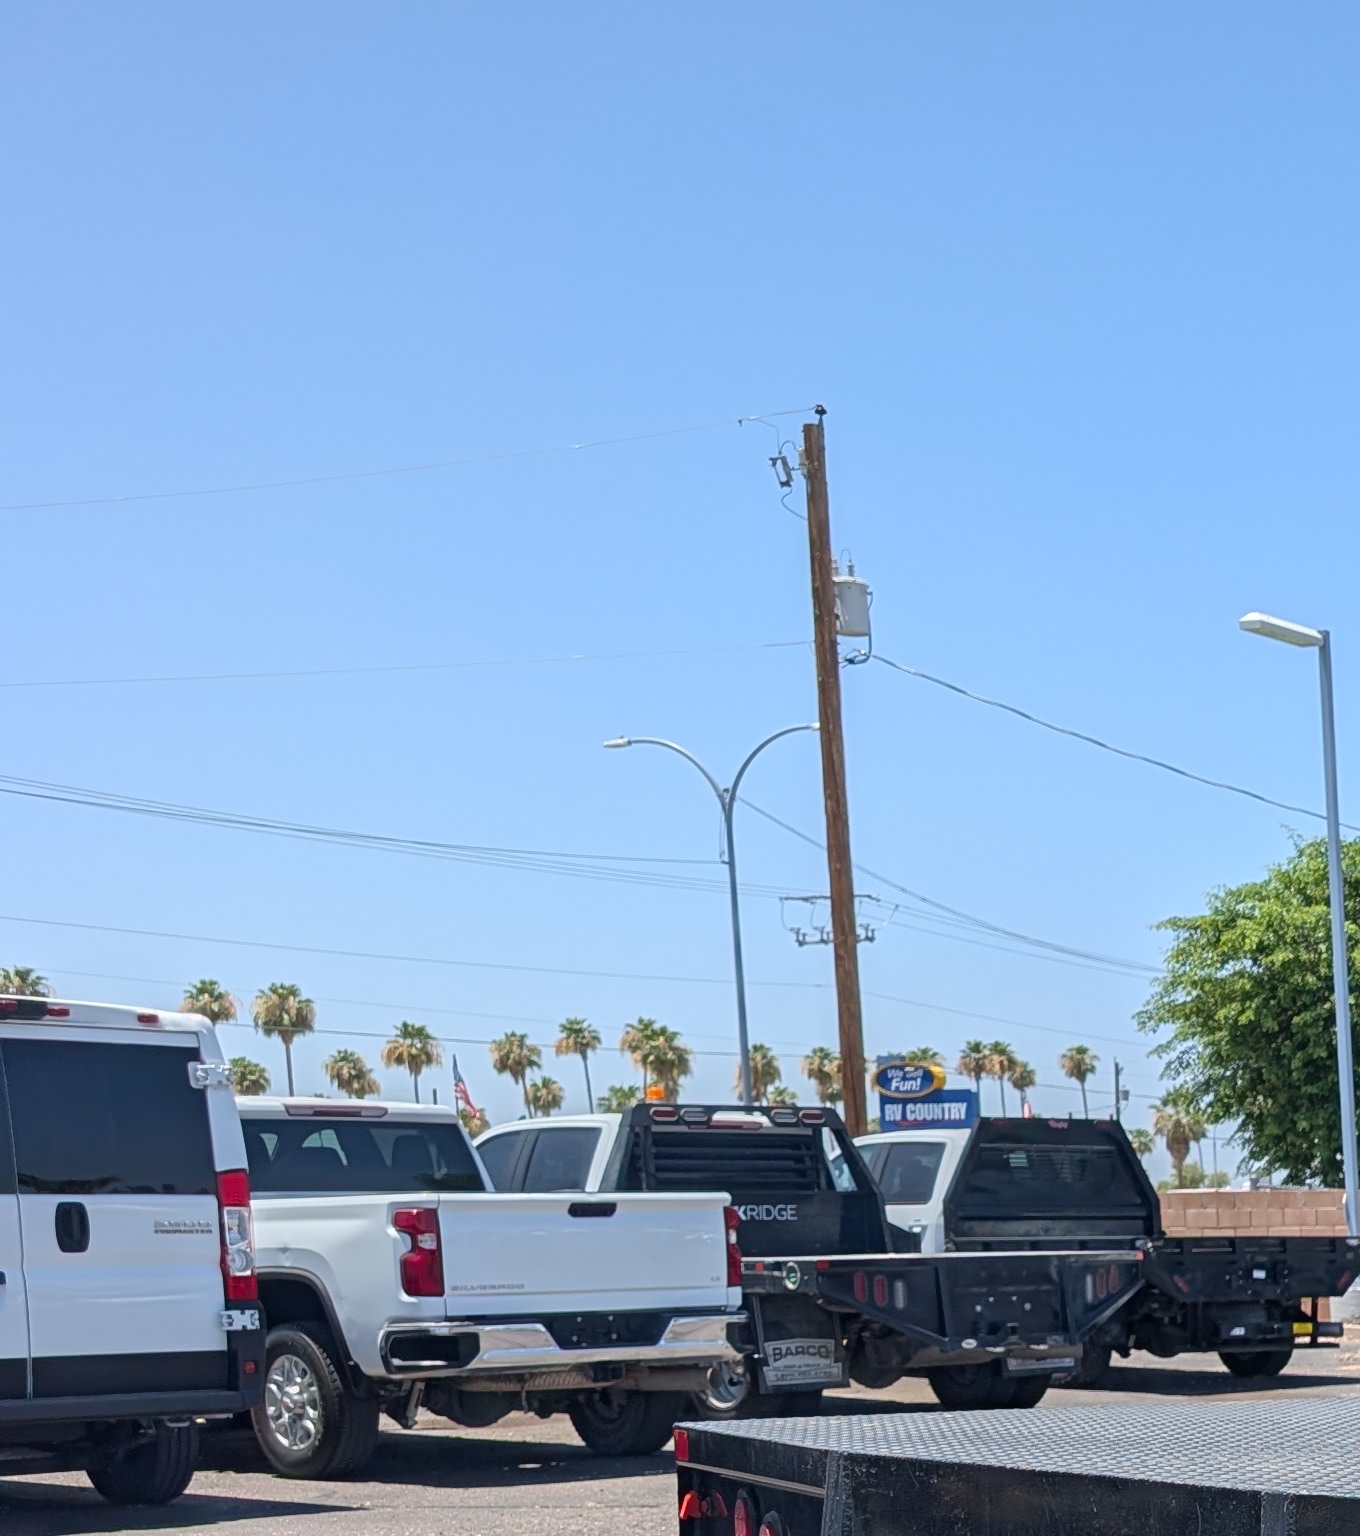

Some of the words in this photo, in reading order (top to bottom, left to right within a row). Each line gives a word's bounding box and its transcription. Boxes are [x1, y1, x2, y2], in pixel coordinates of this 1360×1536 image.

[887, 1069, 904, 1078] We
[891, 1077, 921, 1091] Fun!
[884, 1104, 902, 1121] RV
[906, 1102, 967, 1120] COUNTRY
[451, 1283, 525, 1292] SILVERADO
[772, 1345, 830, 1363] BARCO
